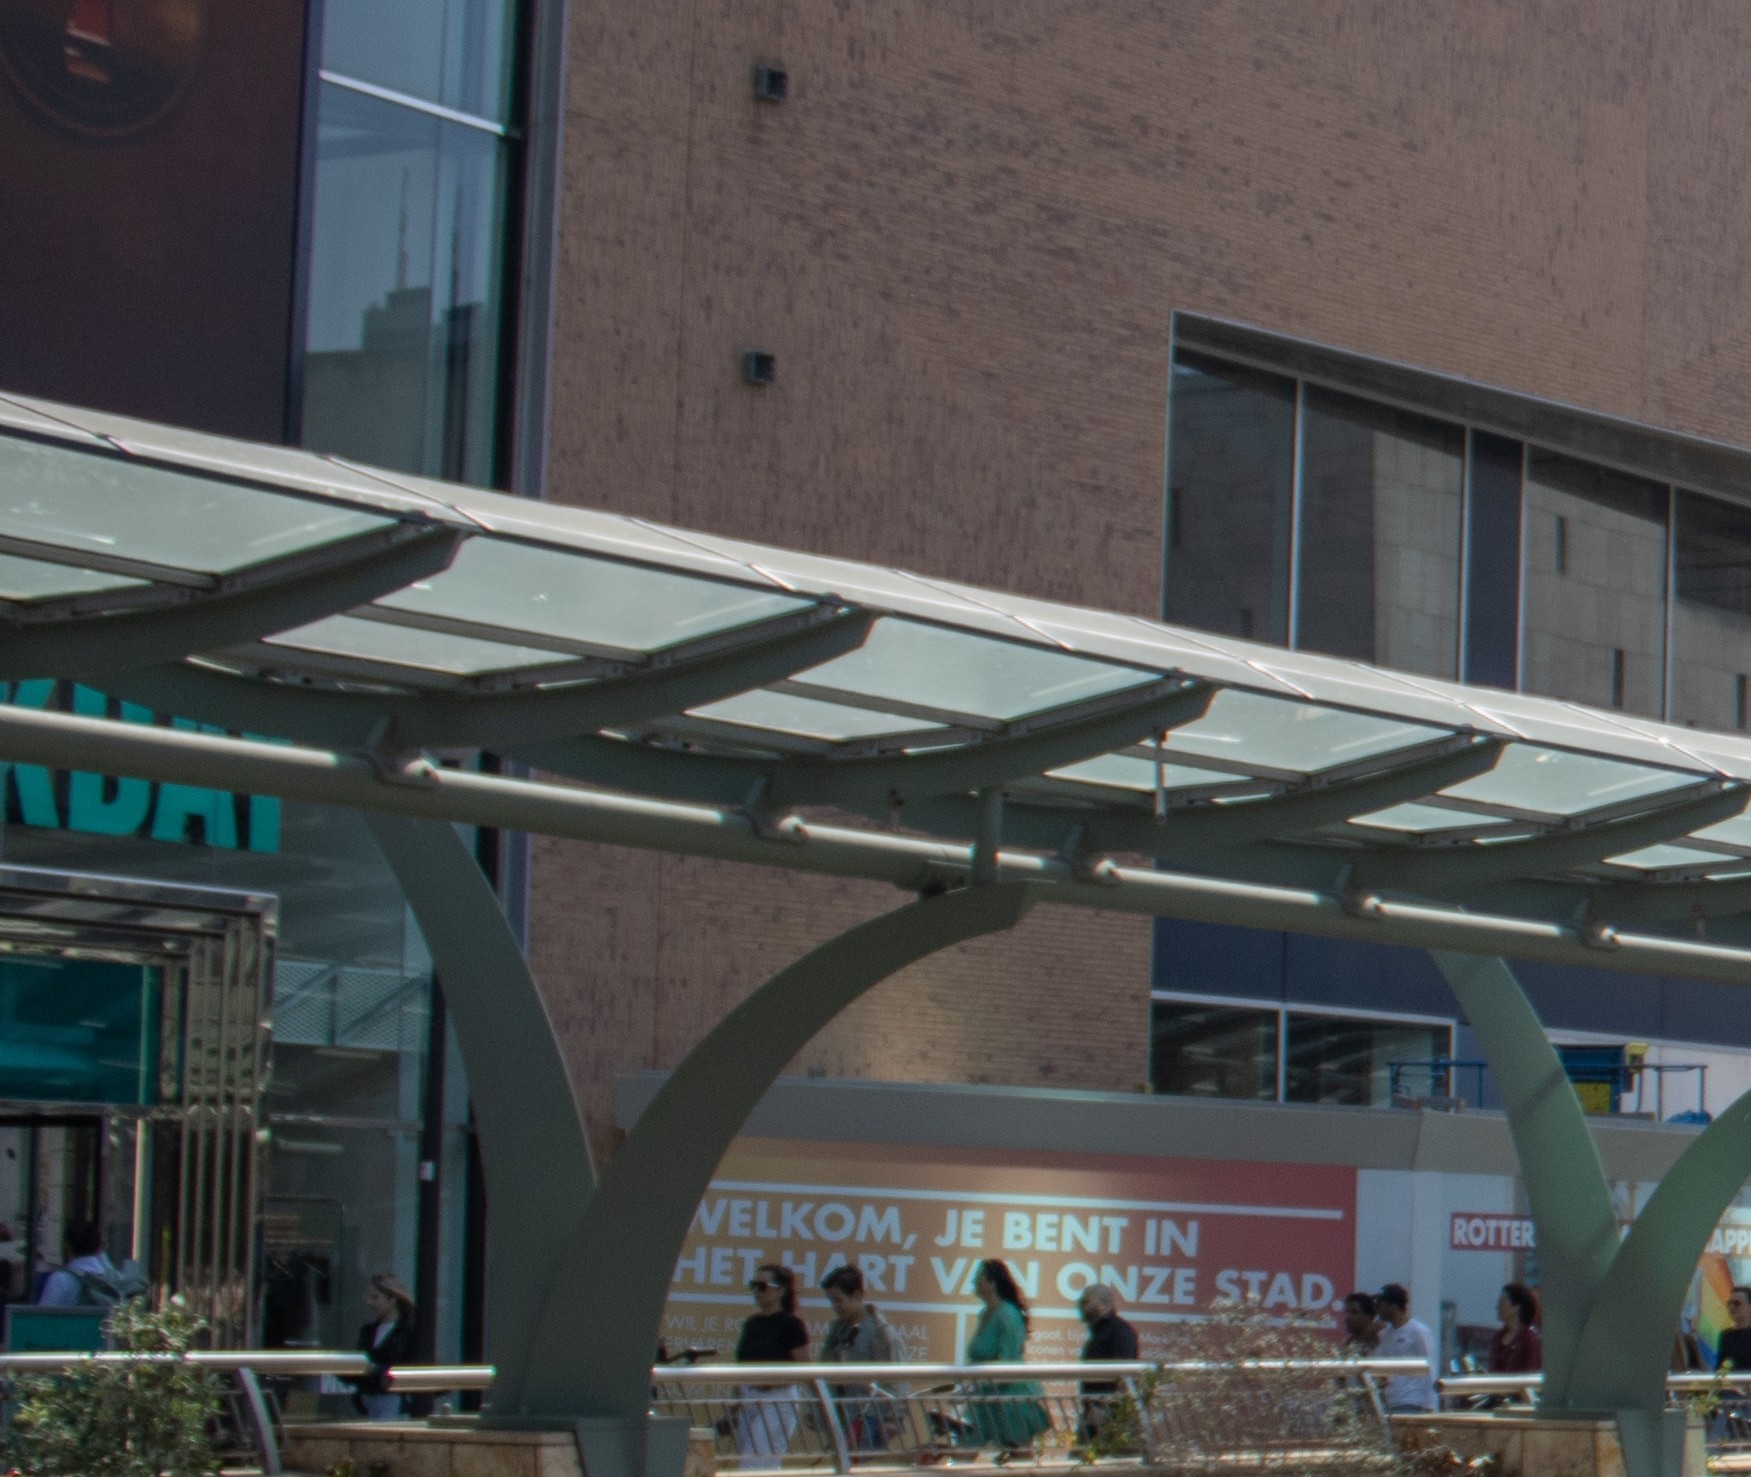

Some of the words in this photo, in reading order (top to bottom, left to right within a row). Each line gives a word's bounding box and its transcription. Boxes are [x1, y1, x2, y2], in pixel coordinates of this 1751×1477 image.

[690, 1199, 918, 1250] WELKOM,
[934, 1209, 986, 1248] JE
[1002, 1212, 1129, 1254] BENT
[1144, 1218, 1198, 1258] IN
[1056, 1261, 1196, 1305] ONZE
[1214, 1269, 1345, 1313] STAD.
